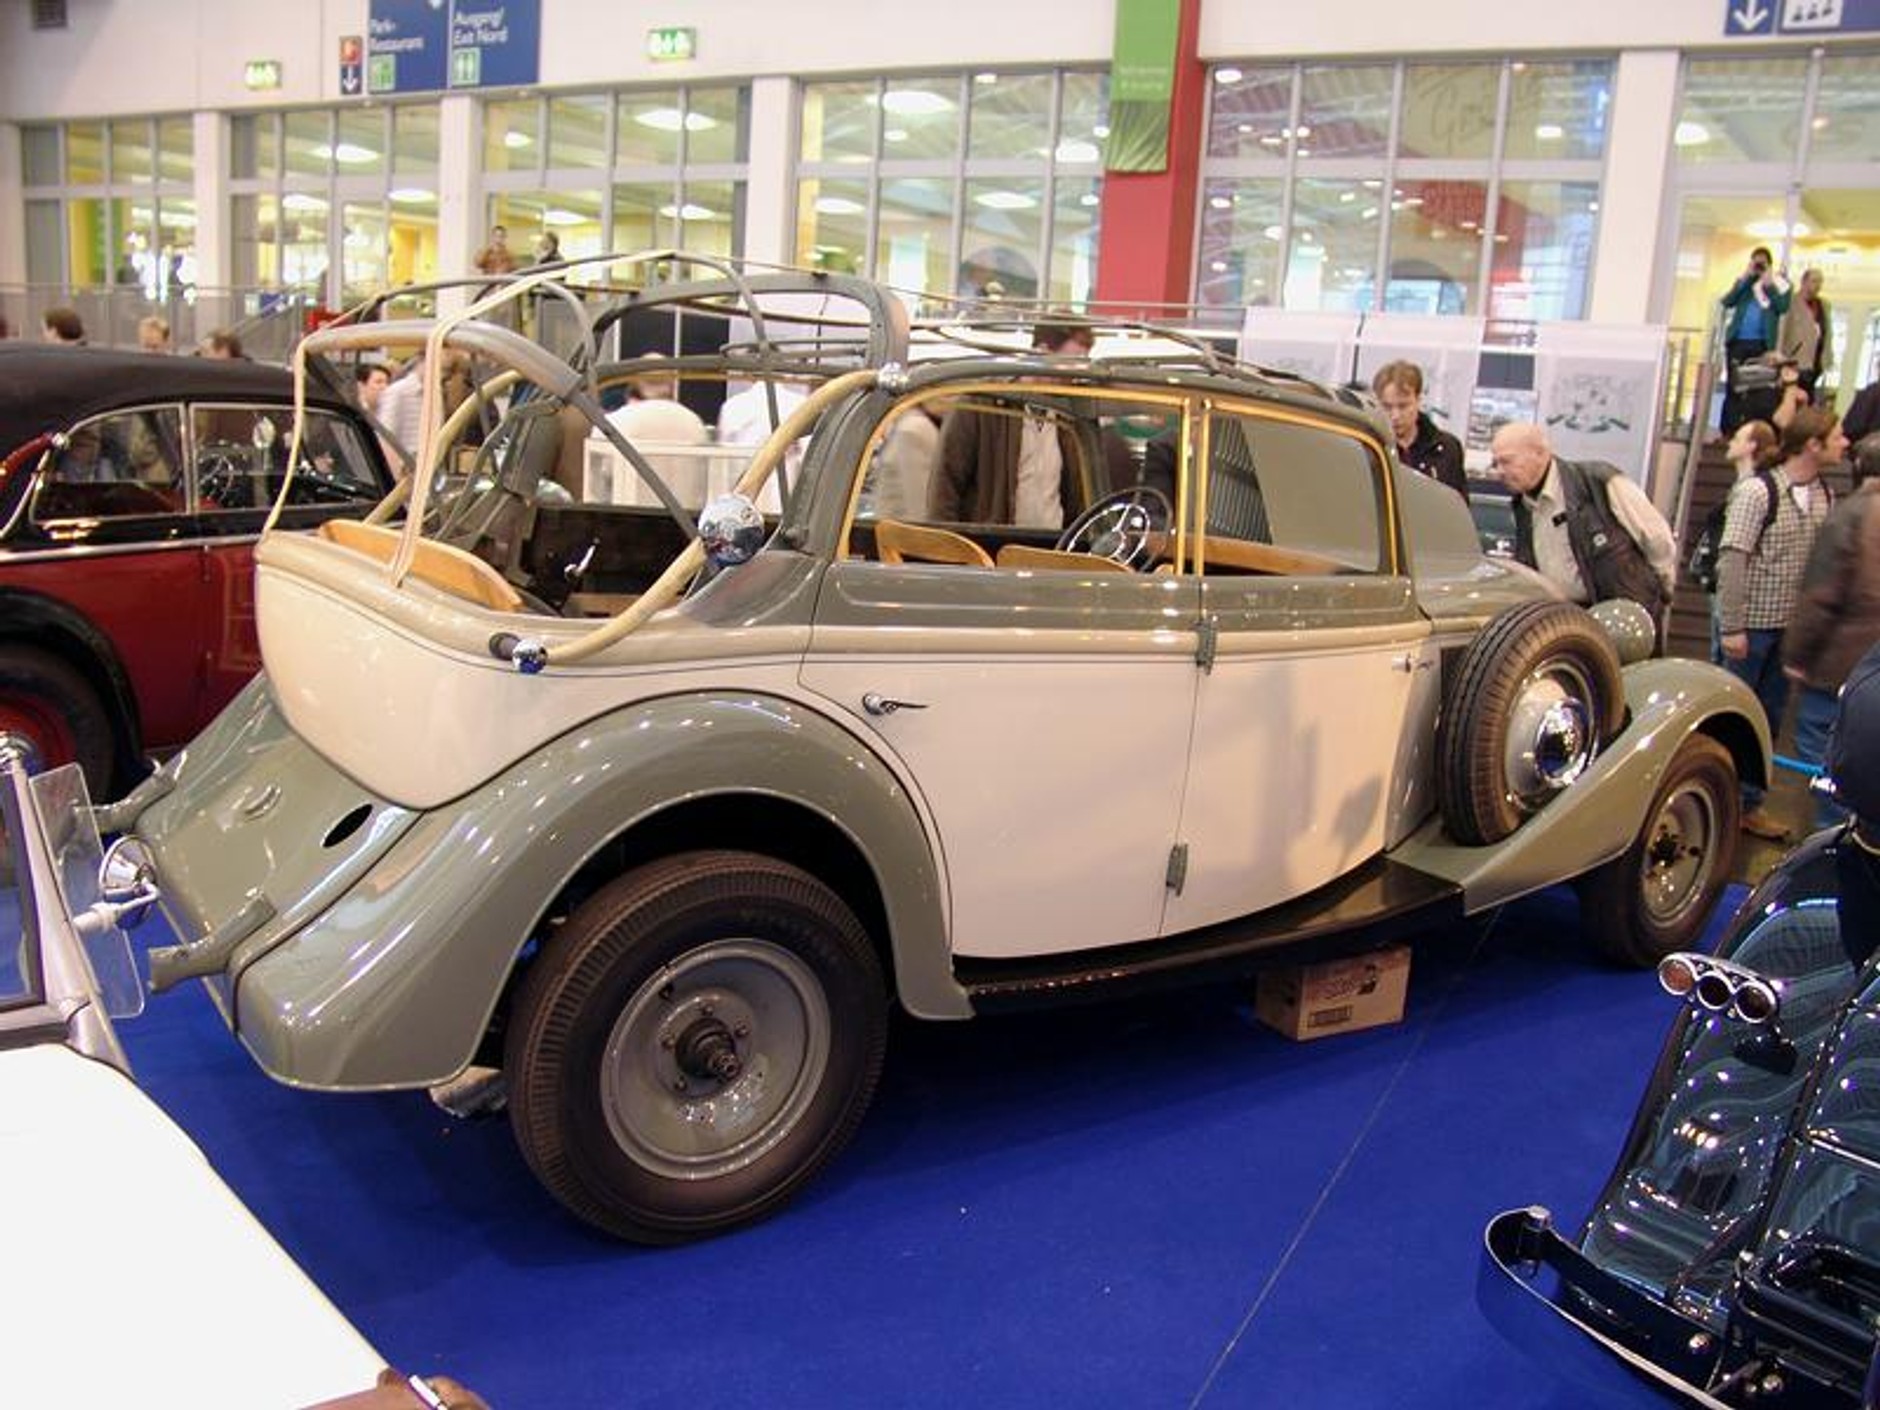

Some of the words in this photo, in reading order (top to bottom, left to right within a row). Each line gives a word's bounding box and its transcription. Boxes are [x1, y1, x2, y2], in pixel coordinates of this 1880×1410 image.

[454, 8, 505, 29] Ausgang/
[453, 28, 474, 46] Exit
[477, 26, 508, 43] Nord
